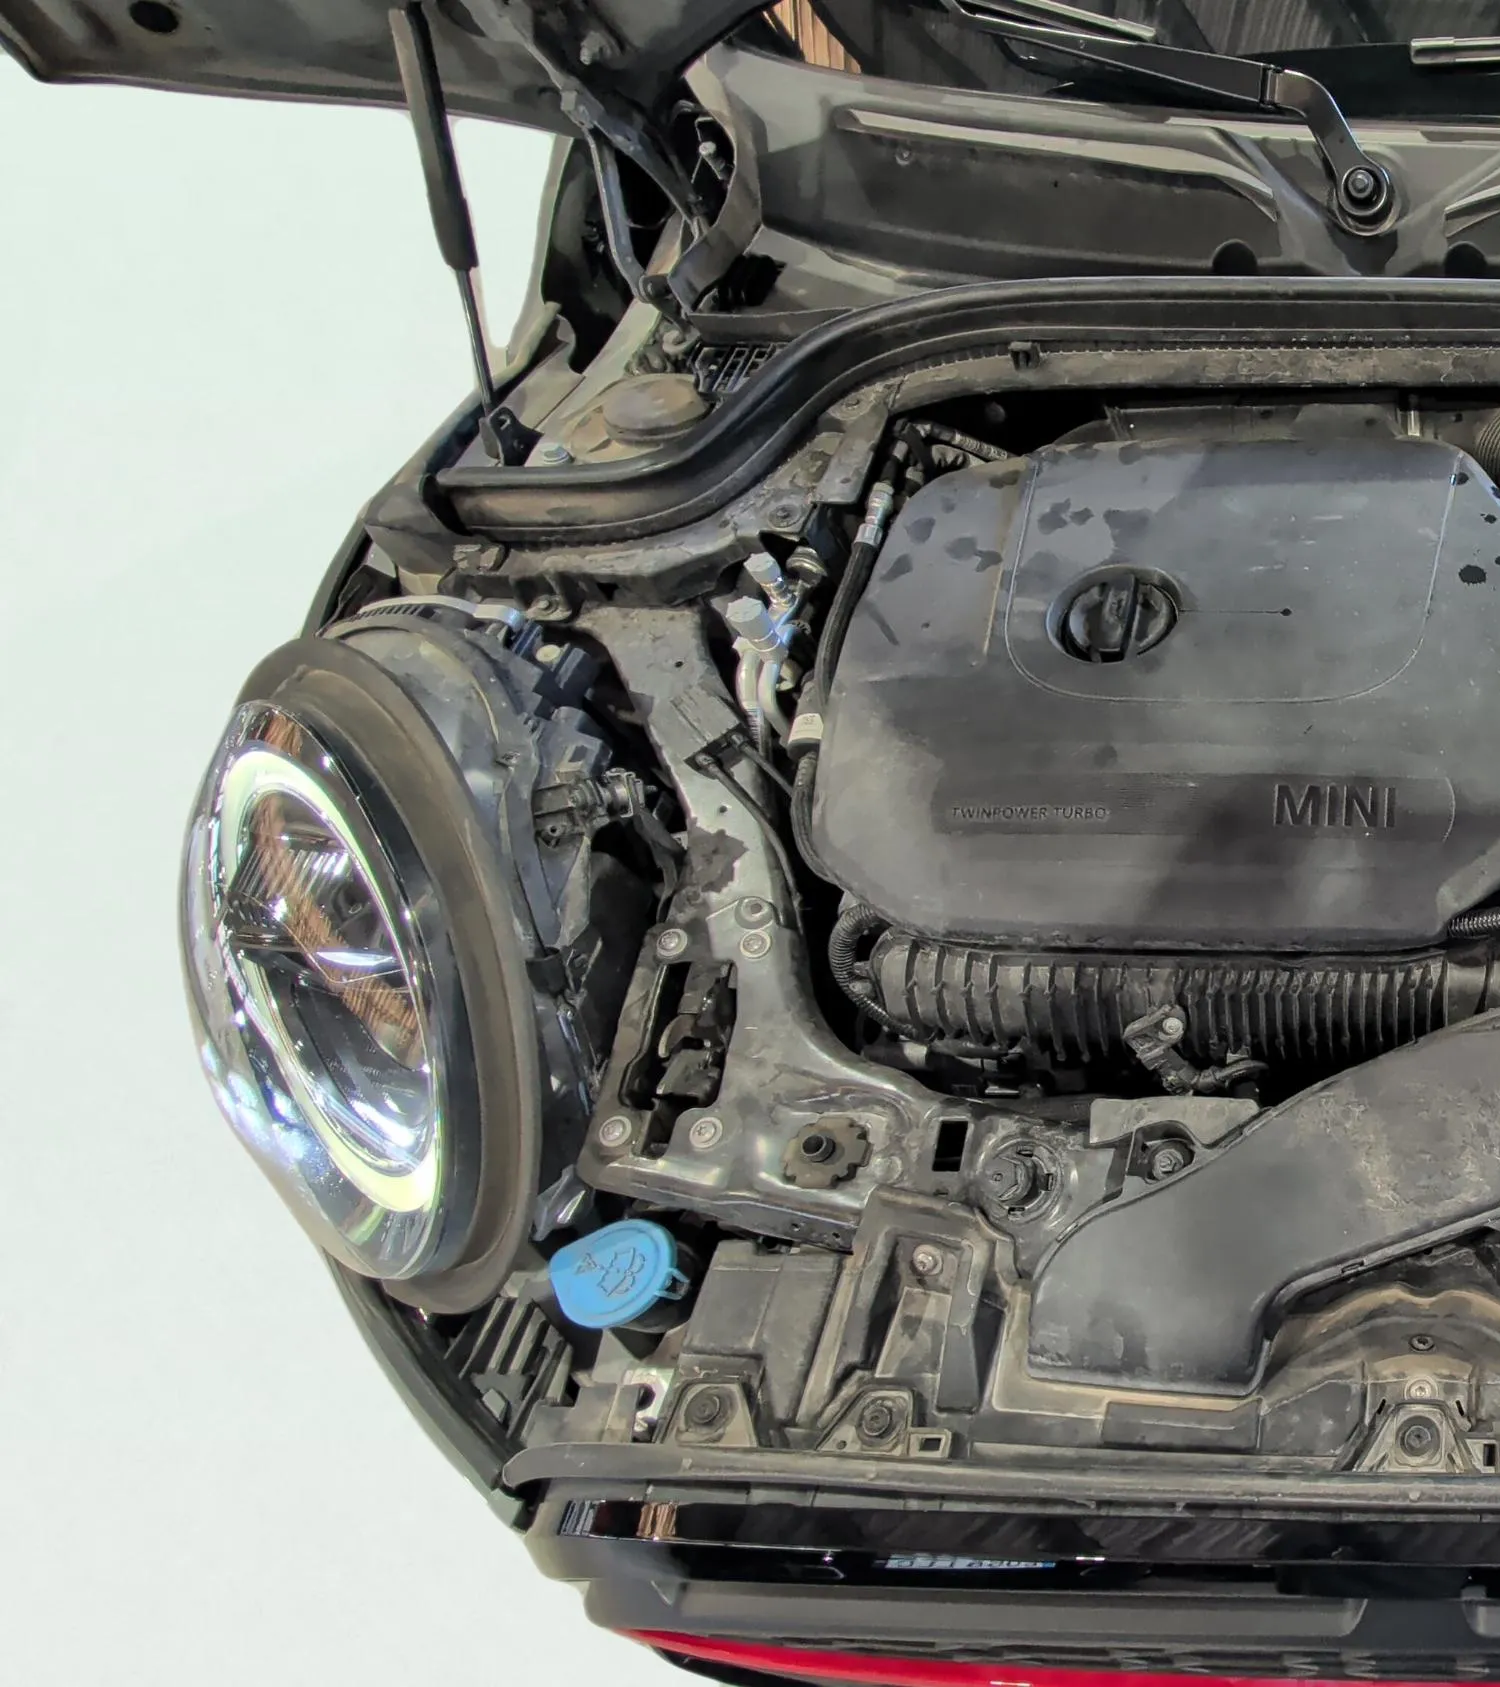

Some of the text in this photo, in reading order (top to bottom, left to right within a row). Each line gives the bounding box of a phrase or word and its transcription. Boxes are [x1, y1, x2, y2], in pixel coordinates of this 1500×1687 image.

[952, 806, 1107, 820] TWINPOWER TURBO
[1273, 784, 1396, 828] MINI
